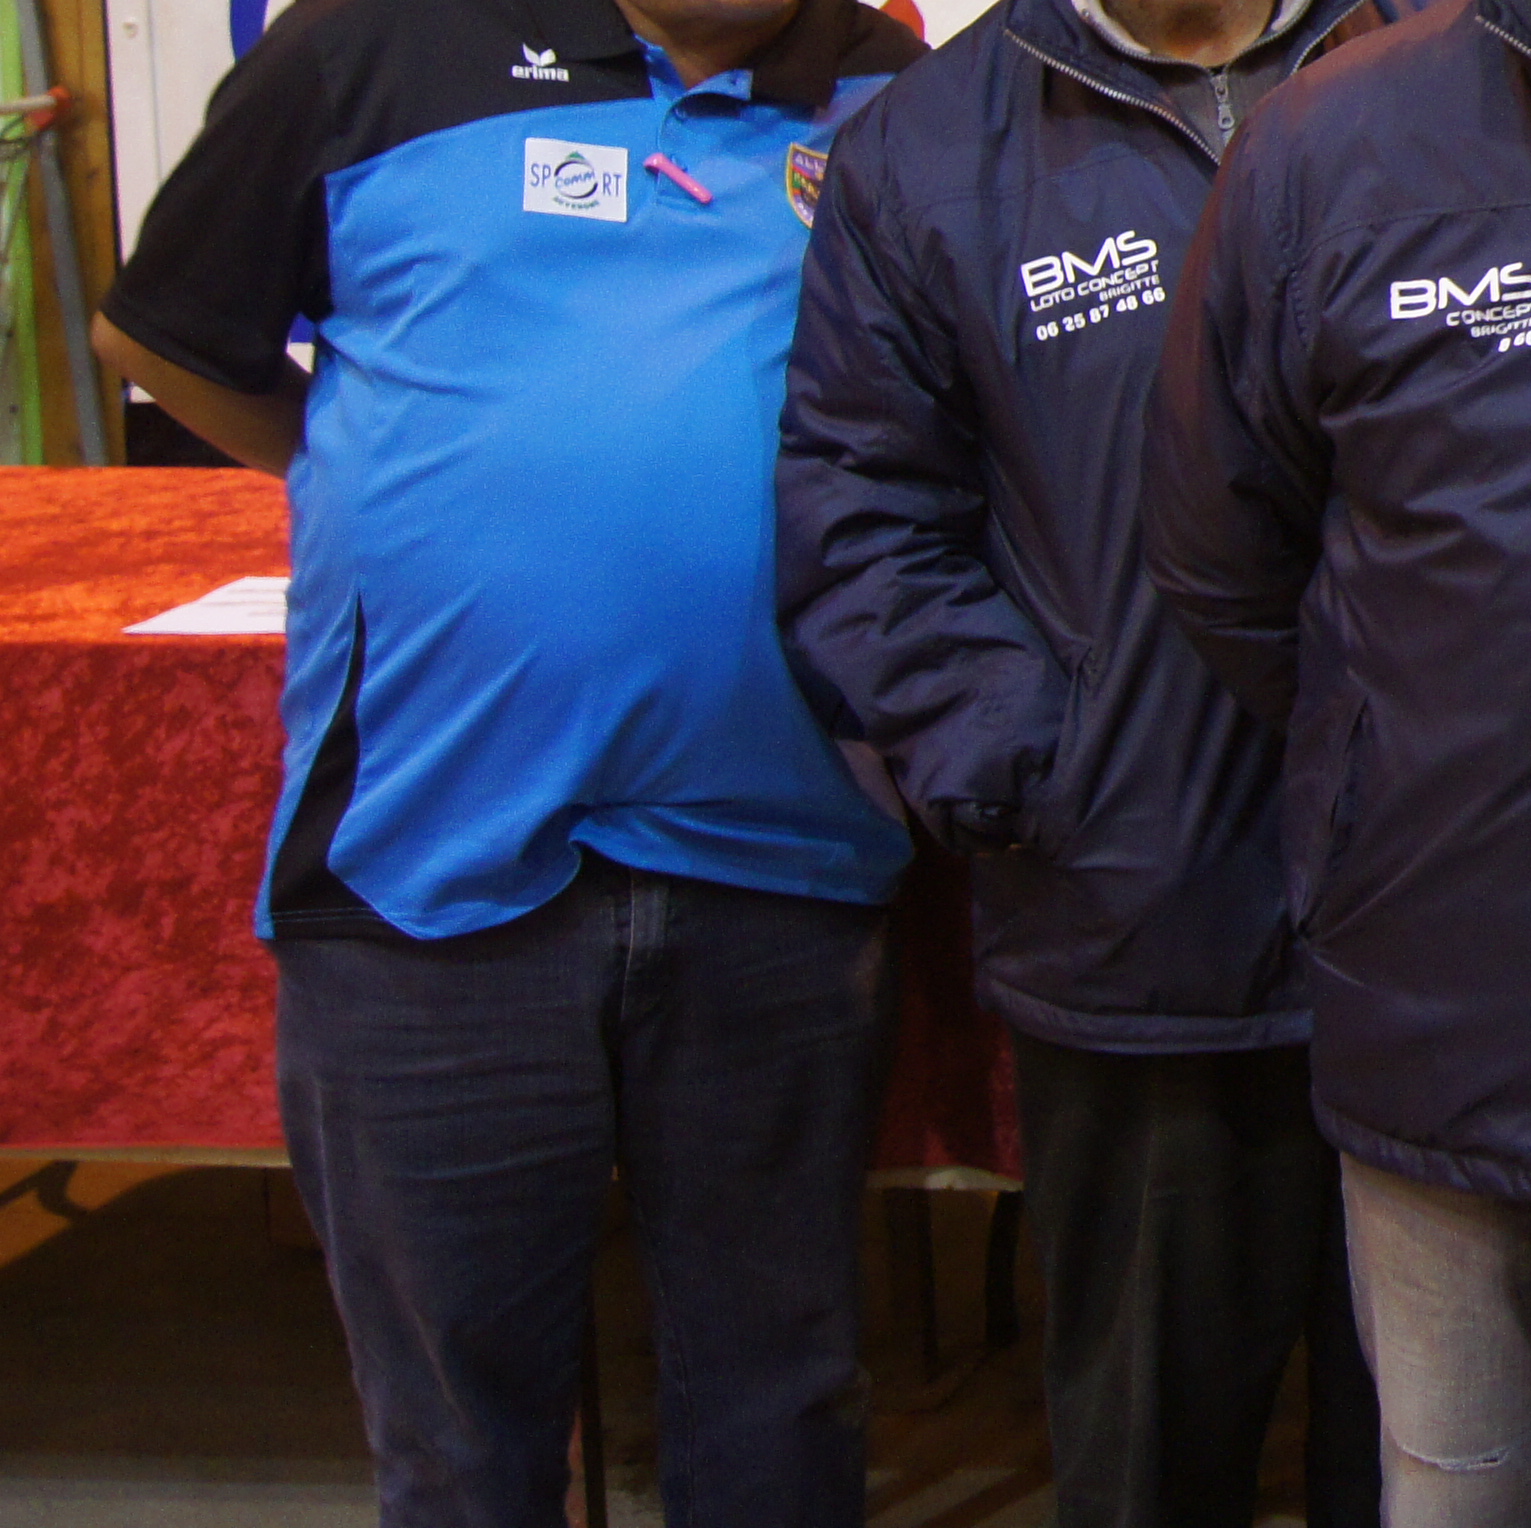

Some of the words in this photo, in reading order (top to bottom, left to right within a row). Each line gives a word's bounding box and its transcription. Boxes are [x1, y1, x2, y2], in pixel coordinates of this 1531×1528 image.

[1019, 229, 1159, 298] BMS
[1029, 286, 1076, 312] LOTO
[1076, 259, 1160, 297] CONCEPT
[1098, 273, 1161, 303] BRIGITTE
[1035, 320, 1060, 342] 06
[1062, 312, 1087, 332] 25
[1088, 303, 1111, 324] 87
[1115, 294, 1139, 313] 48
[1141, 286, 1167, 306] 66
